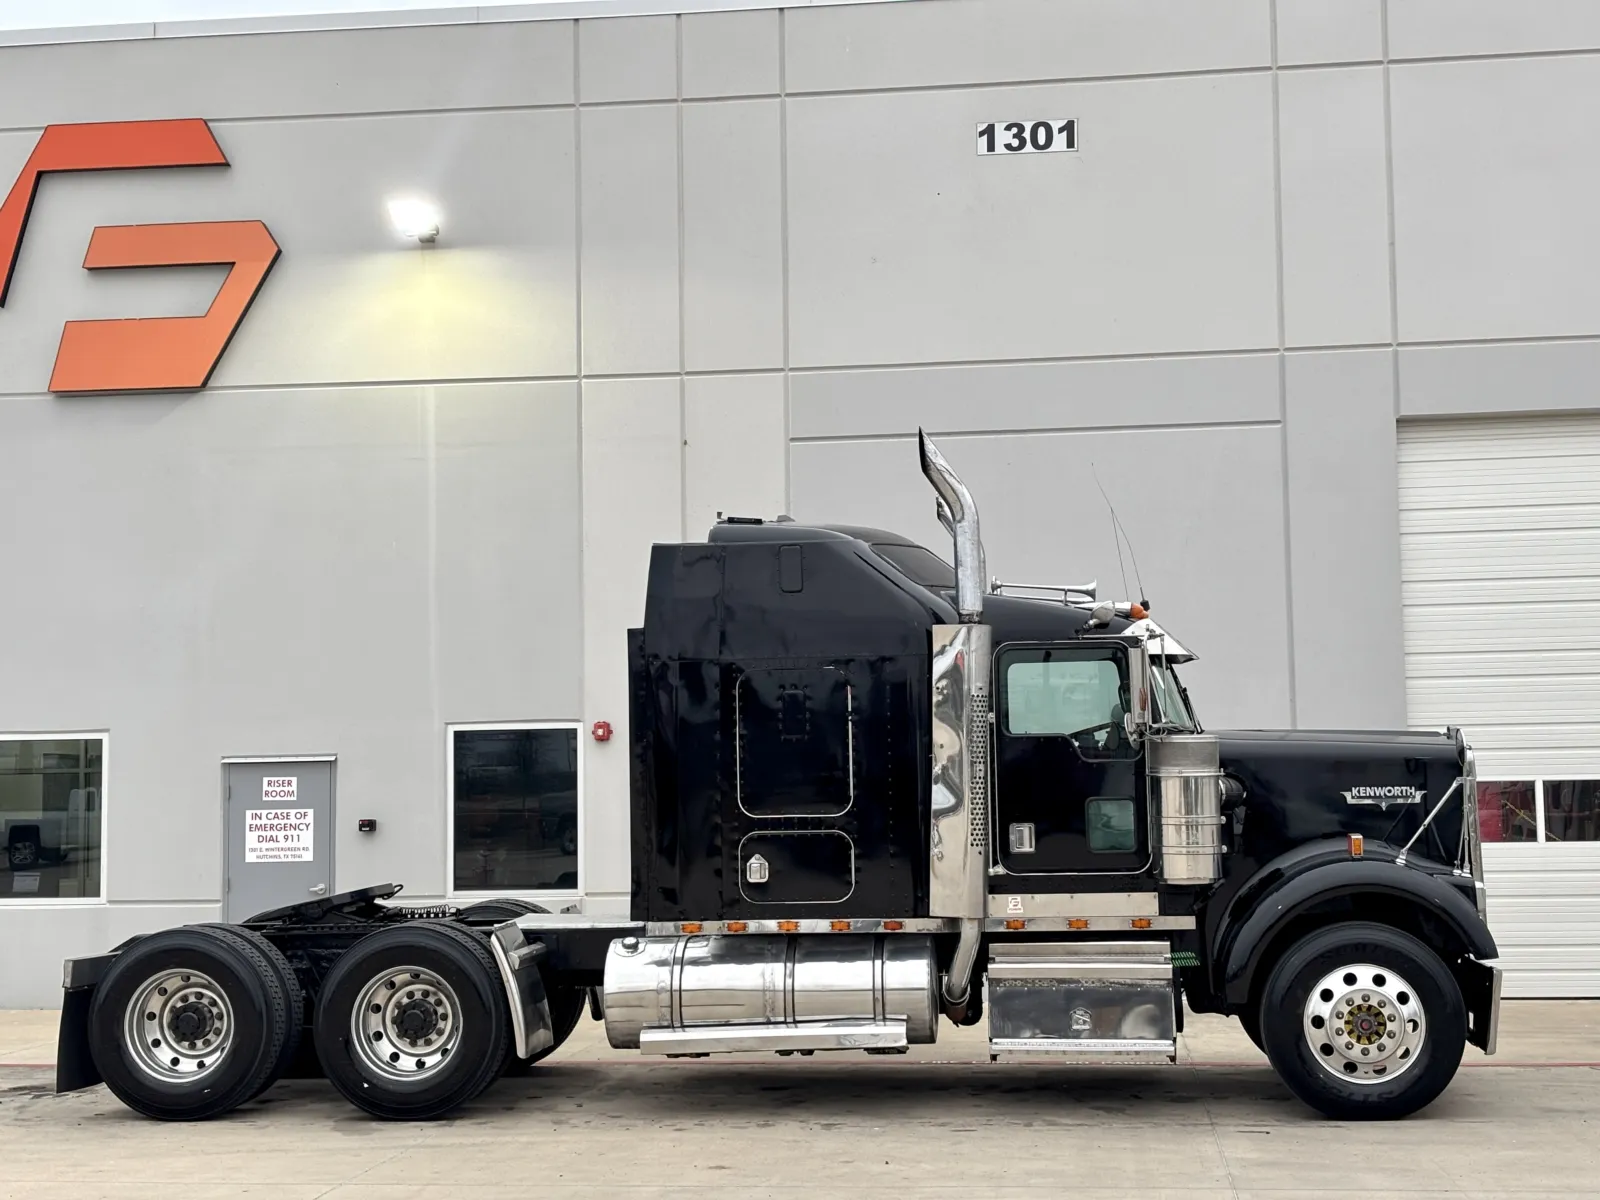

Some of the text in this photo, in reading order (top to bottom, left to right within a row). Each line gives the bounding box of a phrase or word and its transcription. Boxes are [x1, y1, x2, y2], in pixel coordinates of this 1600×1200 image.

[979, 119, 1075, 153] 1301
[267, 779, 293, 788] RISER
[264, 790, 295, 798] ROOM
[1351, 786, 1415, 797] KENWORTH
[251, 811, 309, 820] IN CASE OF
[249, 823, 311, 832] EMERGENCY
[257, 834, 300, 843] DIAL 911
